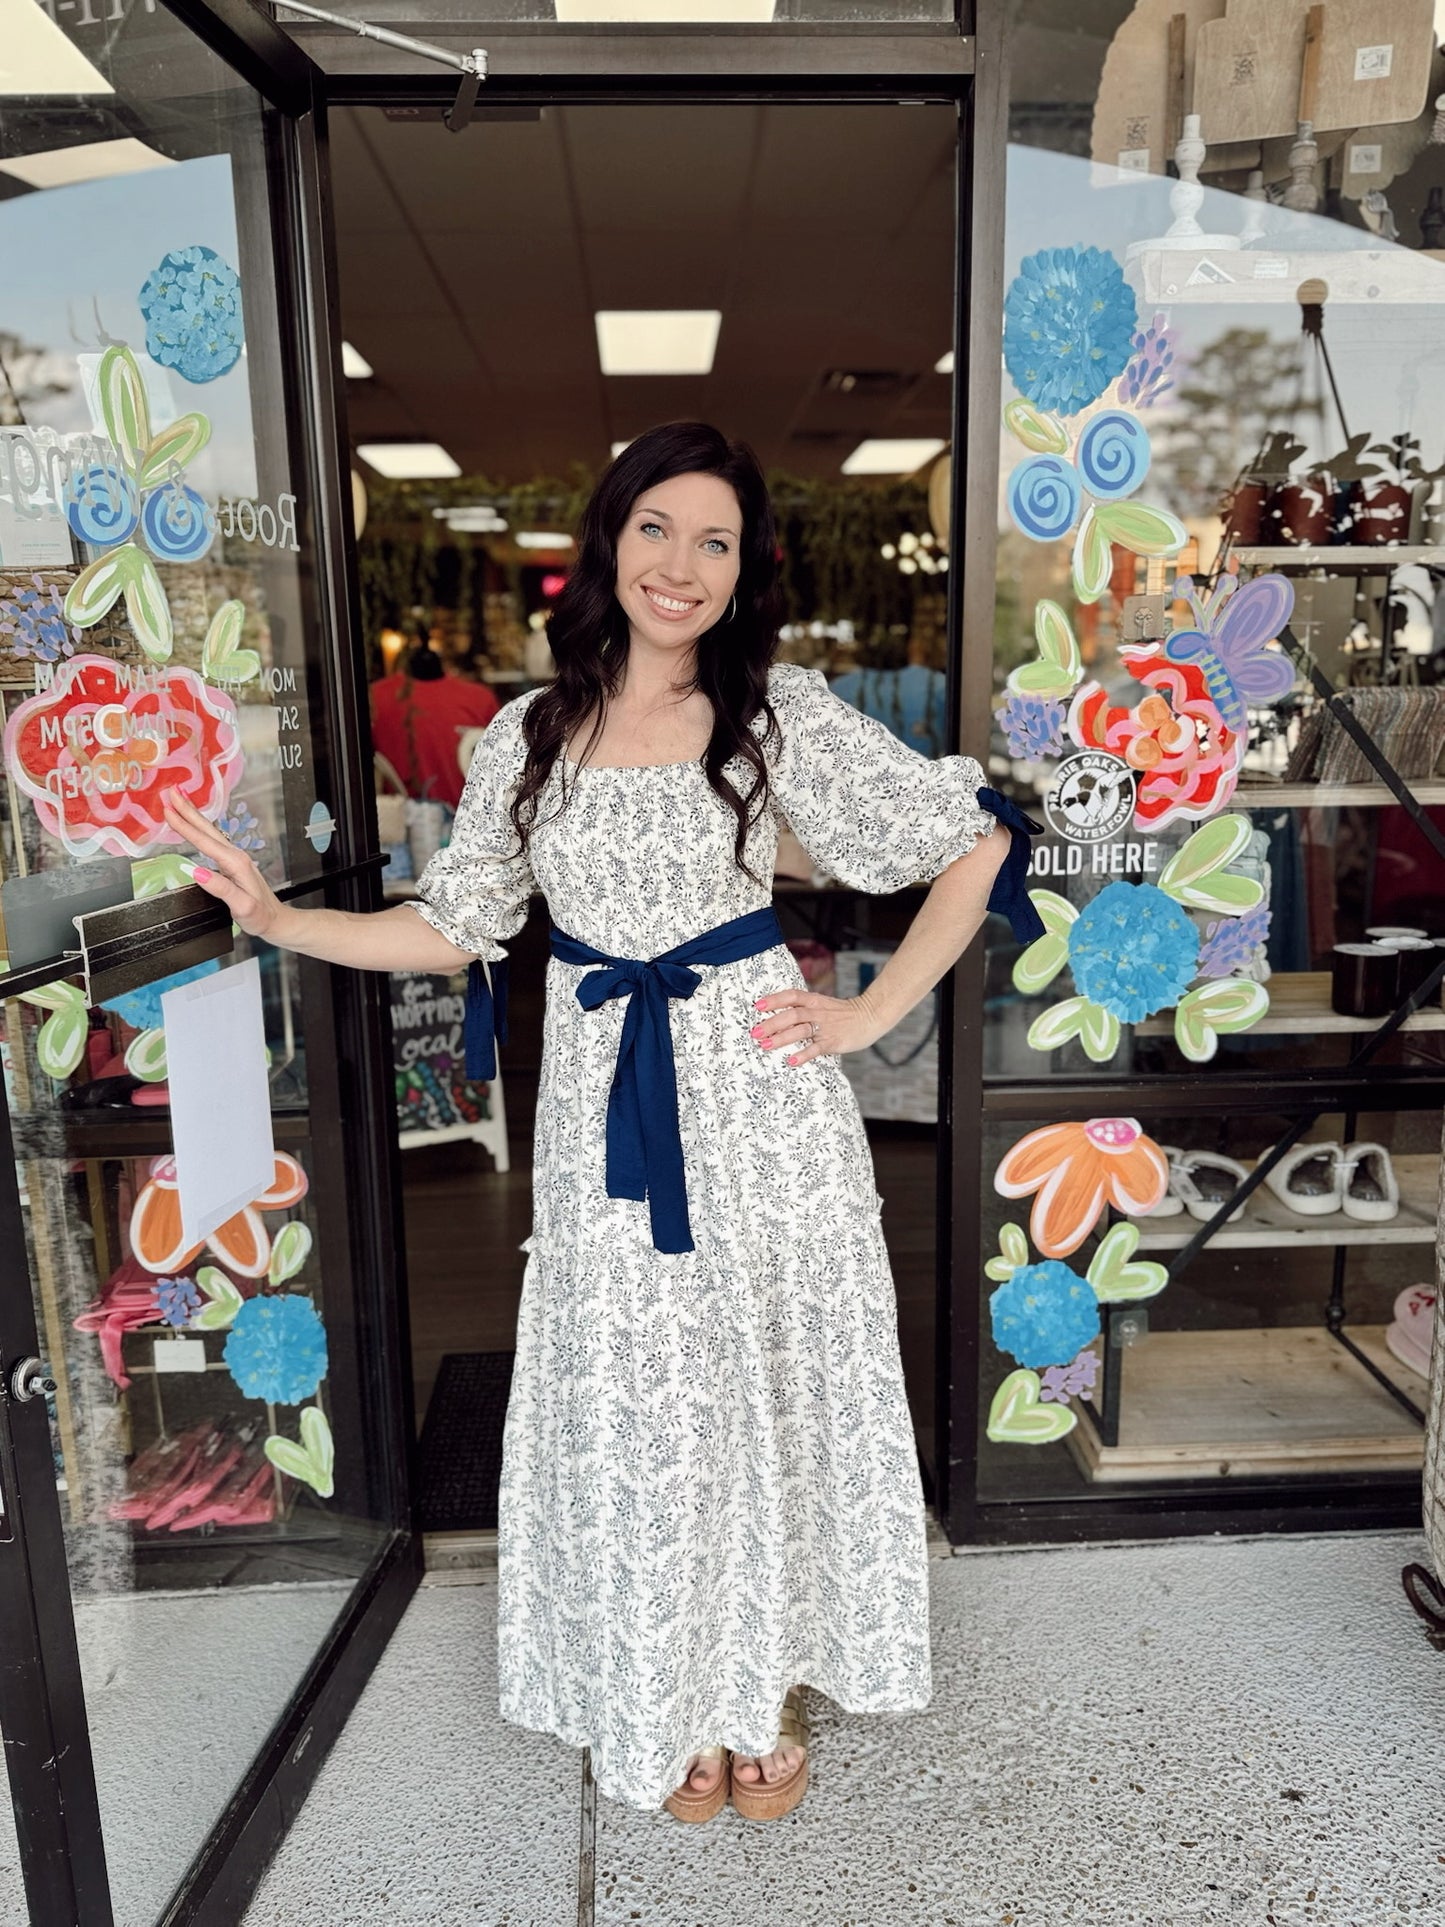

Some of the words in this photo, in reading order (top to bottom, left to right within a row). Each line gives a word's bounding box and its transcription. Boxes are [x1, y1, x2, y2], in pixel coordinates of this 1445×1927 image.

[1081, 756, 1119, 773] OAKS
[1064, 793, 1132, 840] WATERFOWL
[1091, 842, 1159, 875] HERE
